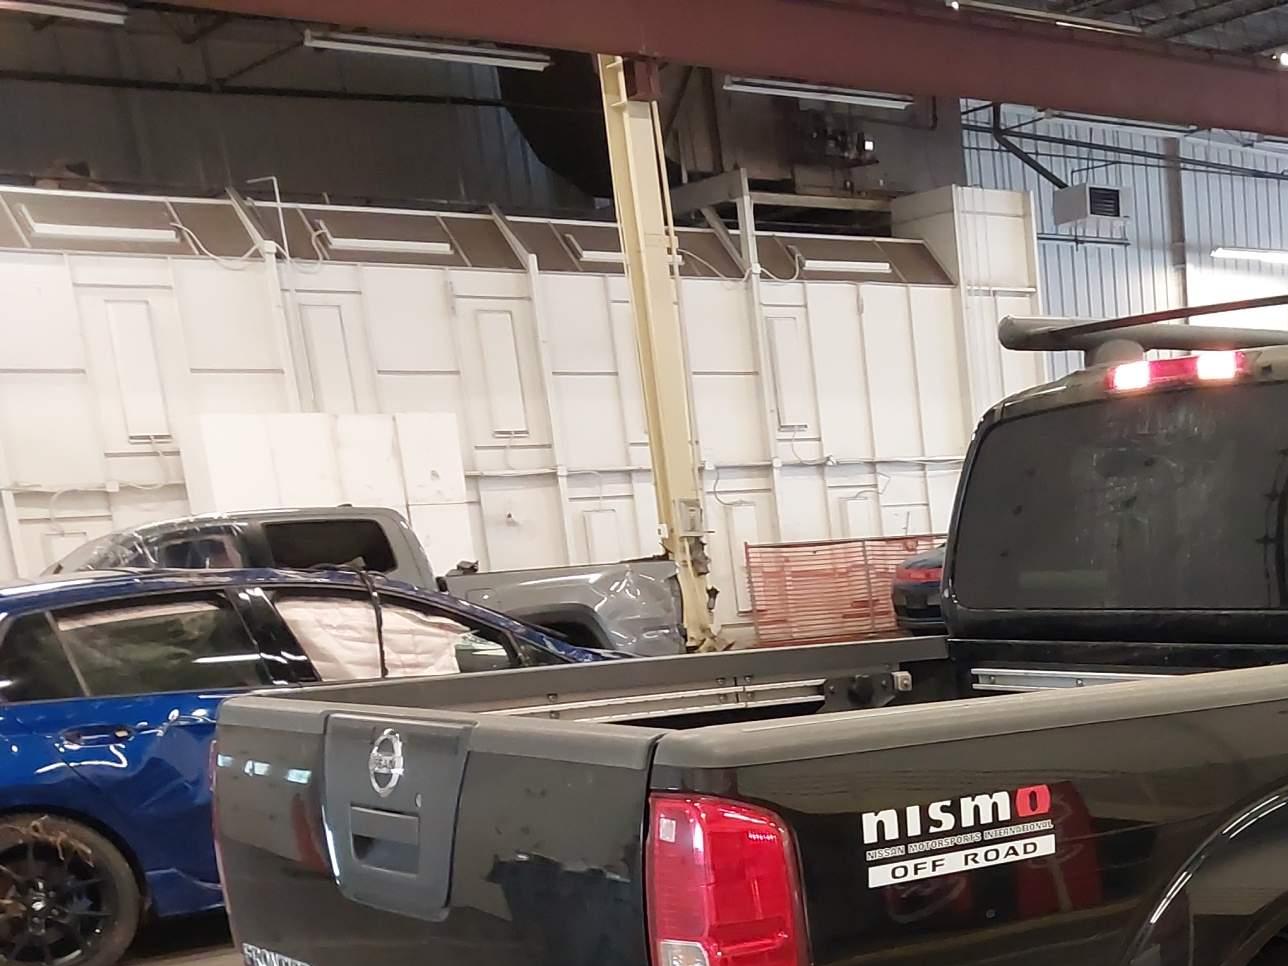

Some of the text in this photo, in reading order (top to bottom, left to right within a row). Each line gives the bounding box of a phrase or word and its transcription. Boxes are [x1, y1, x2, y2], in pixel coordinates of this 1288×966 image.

[862, 784, 1050, 844] nismo
[866, 820, 1054, 861] NISSAN MOTORSPORTS INTERNATIONAL
[891, 841, 1038, 880] OFF ROAD
